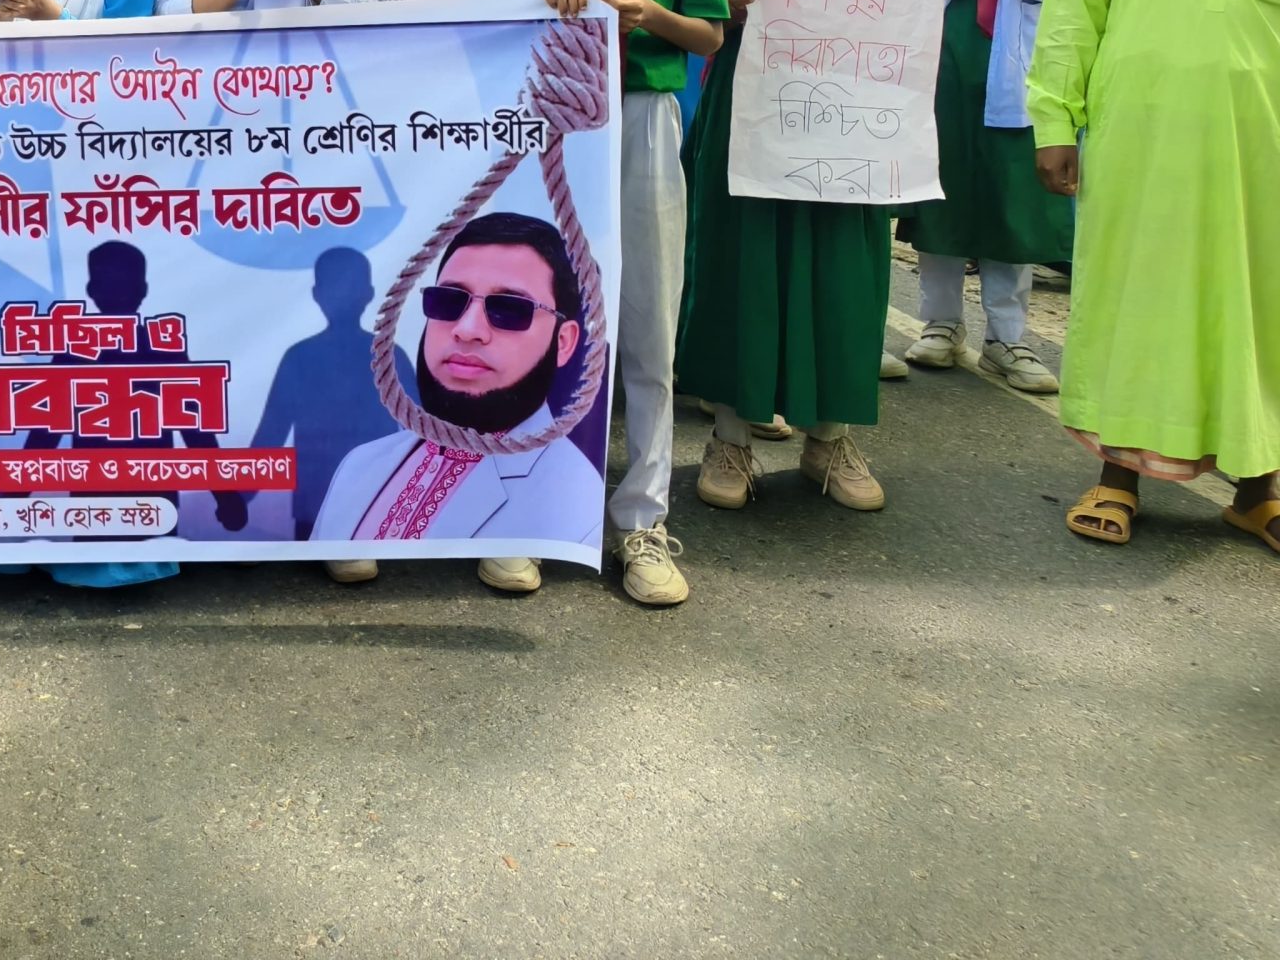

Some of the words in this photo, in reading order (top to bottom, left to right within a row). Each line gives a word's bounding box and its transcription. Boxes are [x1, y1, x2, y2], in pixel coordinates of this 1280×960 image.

[757, 18, 911, 86] নিরাপত্তা
[108, 49, 204, 121] আইন
[213, 60, 337, 117] কোথায়?
[770, 80, 906, 140] নিশ্চিত
[9, 124, 68, 161] উচ্চ
[75, 120, 234, 161] বিদ্যালয়ের
[245, 126, 292, 155] ৮ম
[303, 112, 398, 154] শ্রেণির
[406, 107, 547, 154] শিক্ষার্থীর
[60, 173, 201, 237] ফাঁসির
[211, 170, 363, 233] দাবিতে
[784, 156, 880, 200] কর
[0, 299, 141, 360] মিছিল
[146, 313, 188, 354] ও
[2, 455, 91, 485] স্বপ্নবাজ
[98, 456, 119, 481] ও
[126, 457, 209, 482] সচেতন
[214, 455, 293, 482] জনগণ
[15, 500, 56, 534] খুশি
[62, 505, 113, 530] হোক
[117, 500, 162, 528] স্রষ্টা
